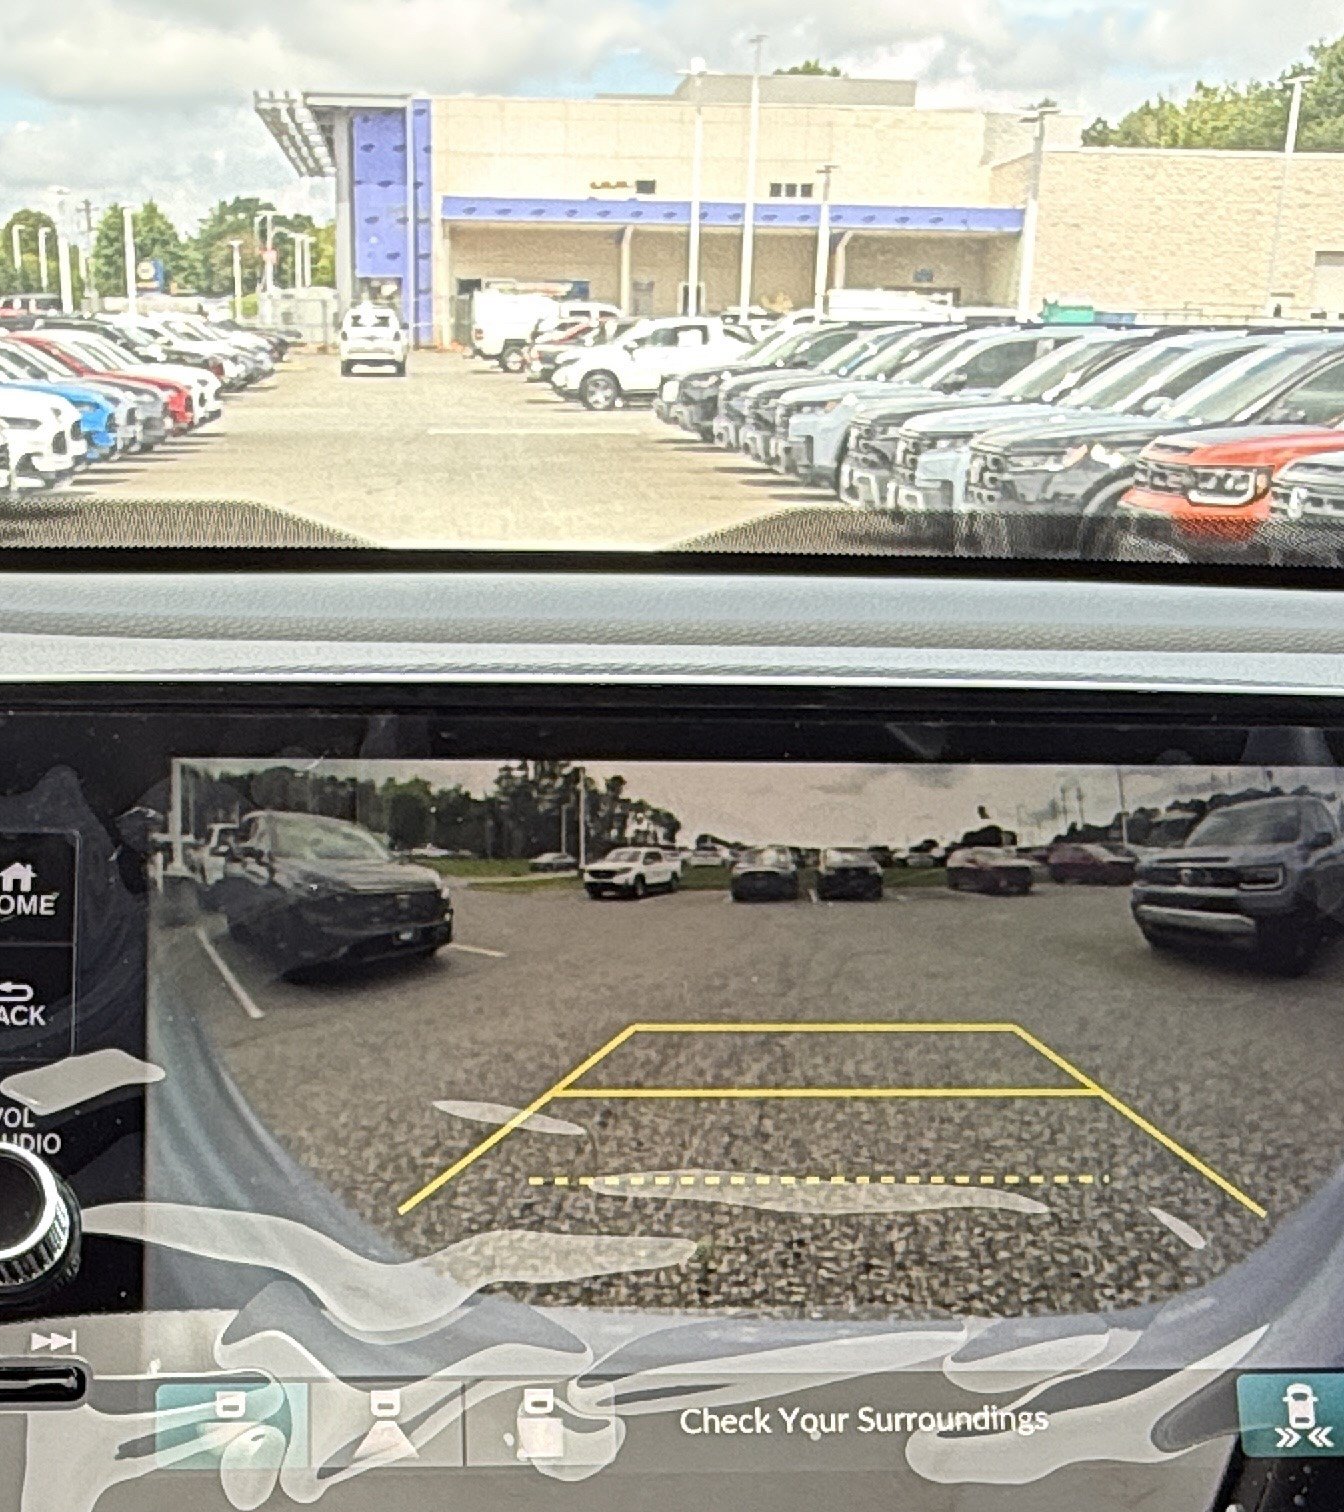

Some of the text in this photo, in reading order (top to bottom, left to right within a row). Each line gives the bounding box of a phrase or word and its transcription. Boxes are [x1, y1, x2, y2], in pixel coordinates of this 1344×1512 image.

[679, 1405, 1050, 1436] Check Your Surroundings
